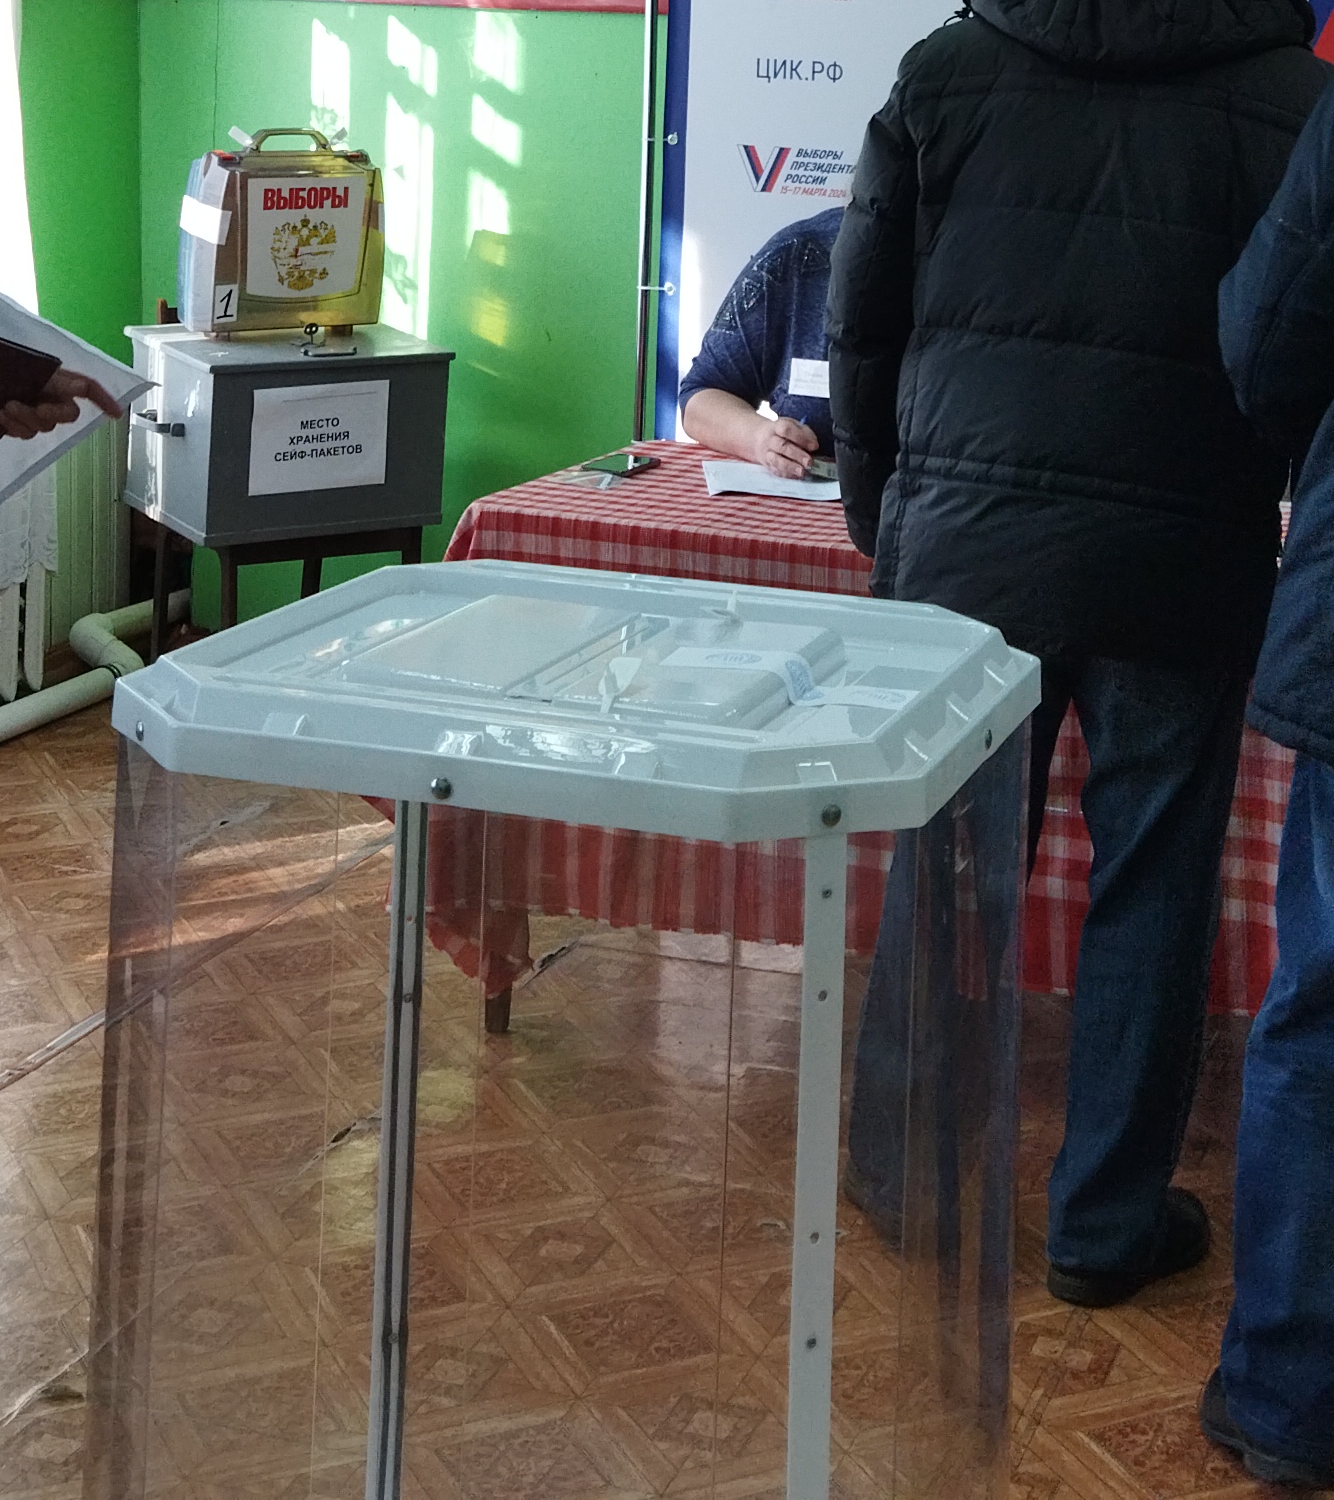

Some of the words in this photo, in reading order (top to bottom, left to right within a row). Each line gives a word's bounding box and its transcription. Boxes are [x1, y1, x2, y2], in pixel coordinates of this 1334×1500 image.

[756, 57, 844, 84] ЦИК.РФ
[796, 148, 843, 160] ВЫБОРЫ
[784, 174, 828, 186] РОССИИ
[263, 186, 349, 211] ВЫБОРЫ
[801, 187, 827, 197] МАРТА
[829, 188, 847, 198] 2024
[216, 289, 234, 319] 1
[300, 417, 340, 430] МЕСТО
[288, 431, 350, 446] ХРАНЕНИЯ
[274, 444, 363, 462] СЕЙФ-ПАКЕТОВ
